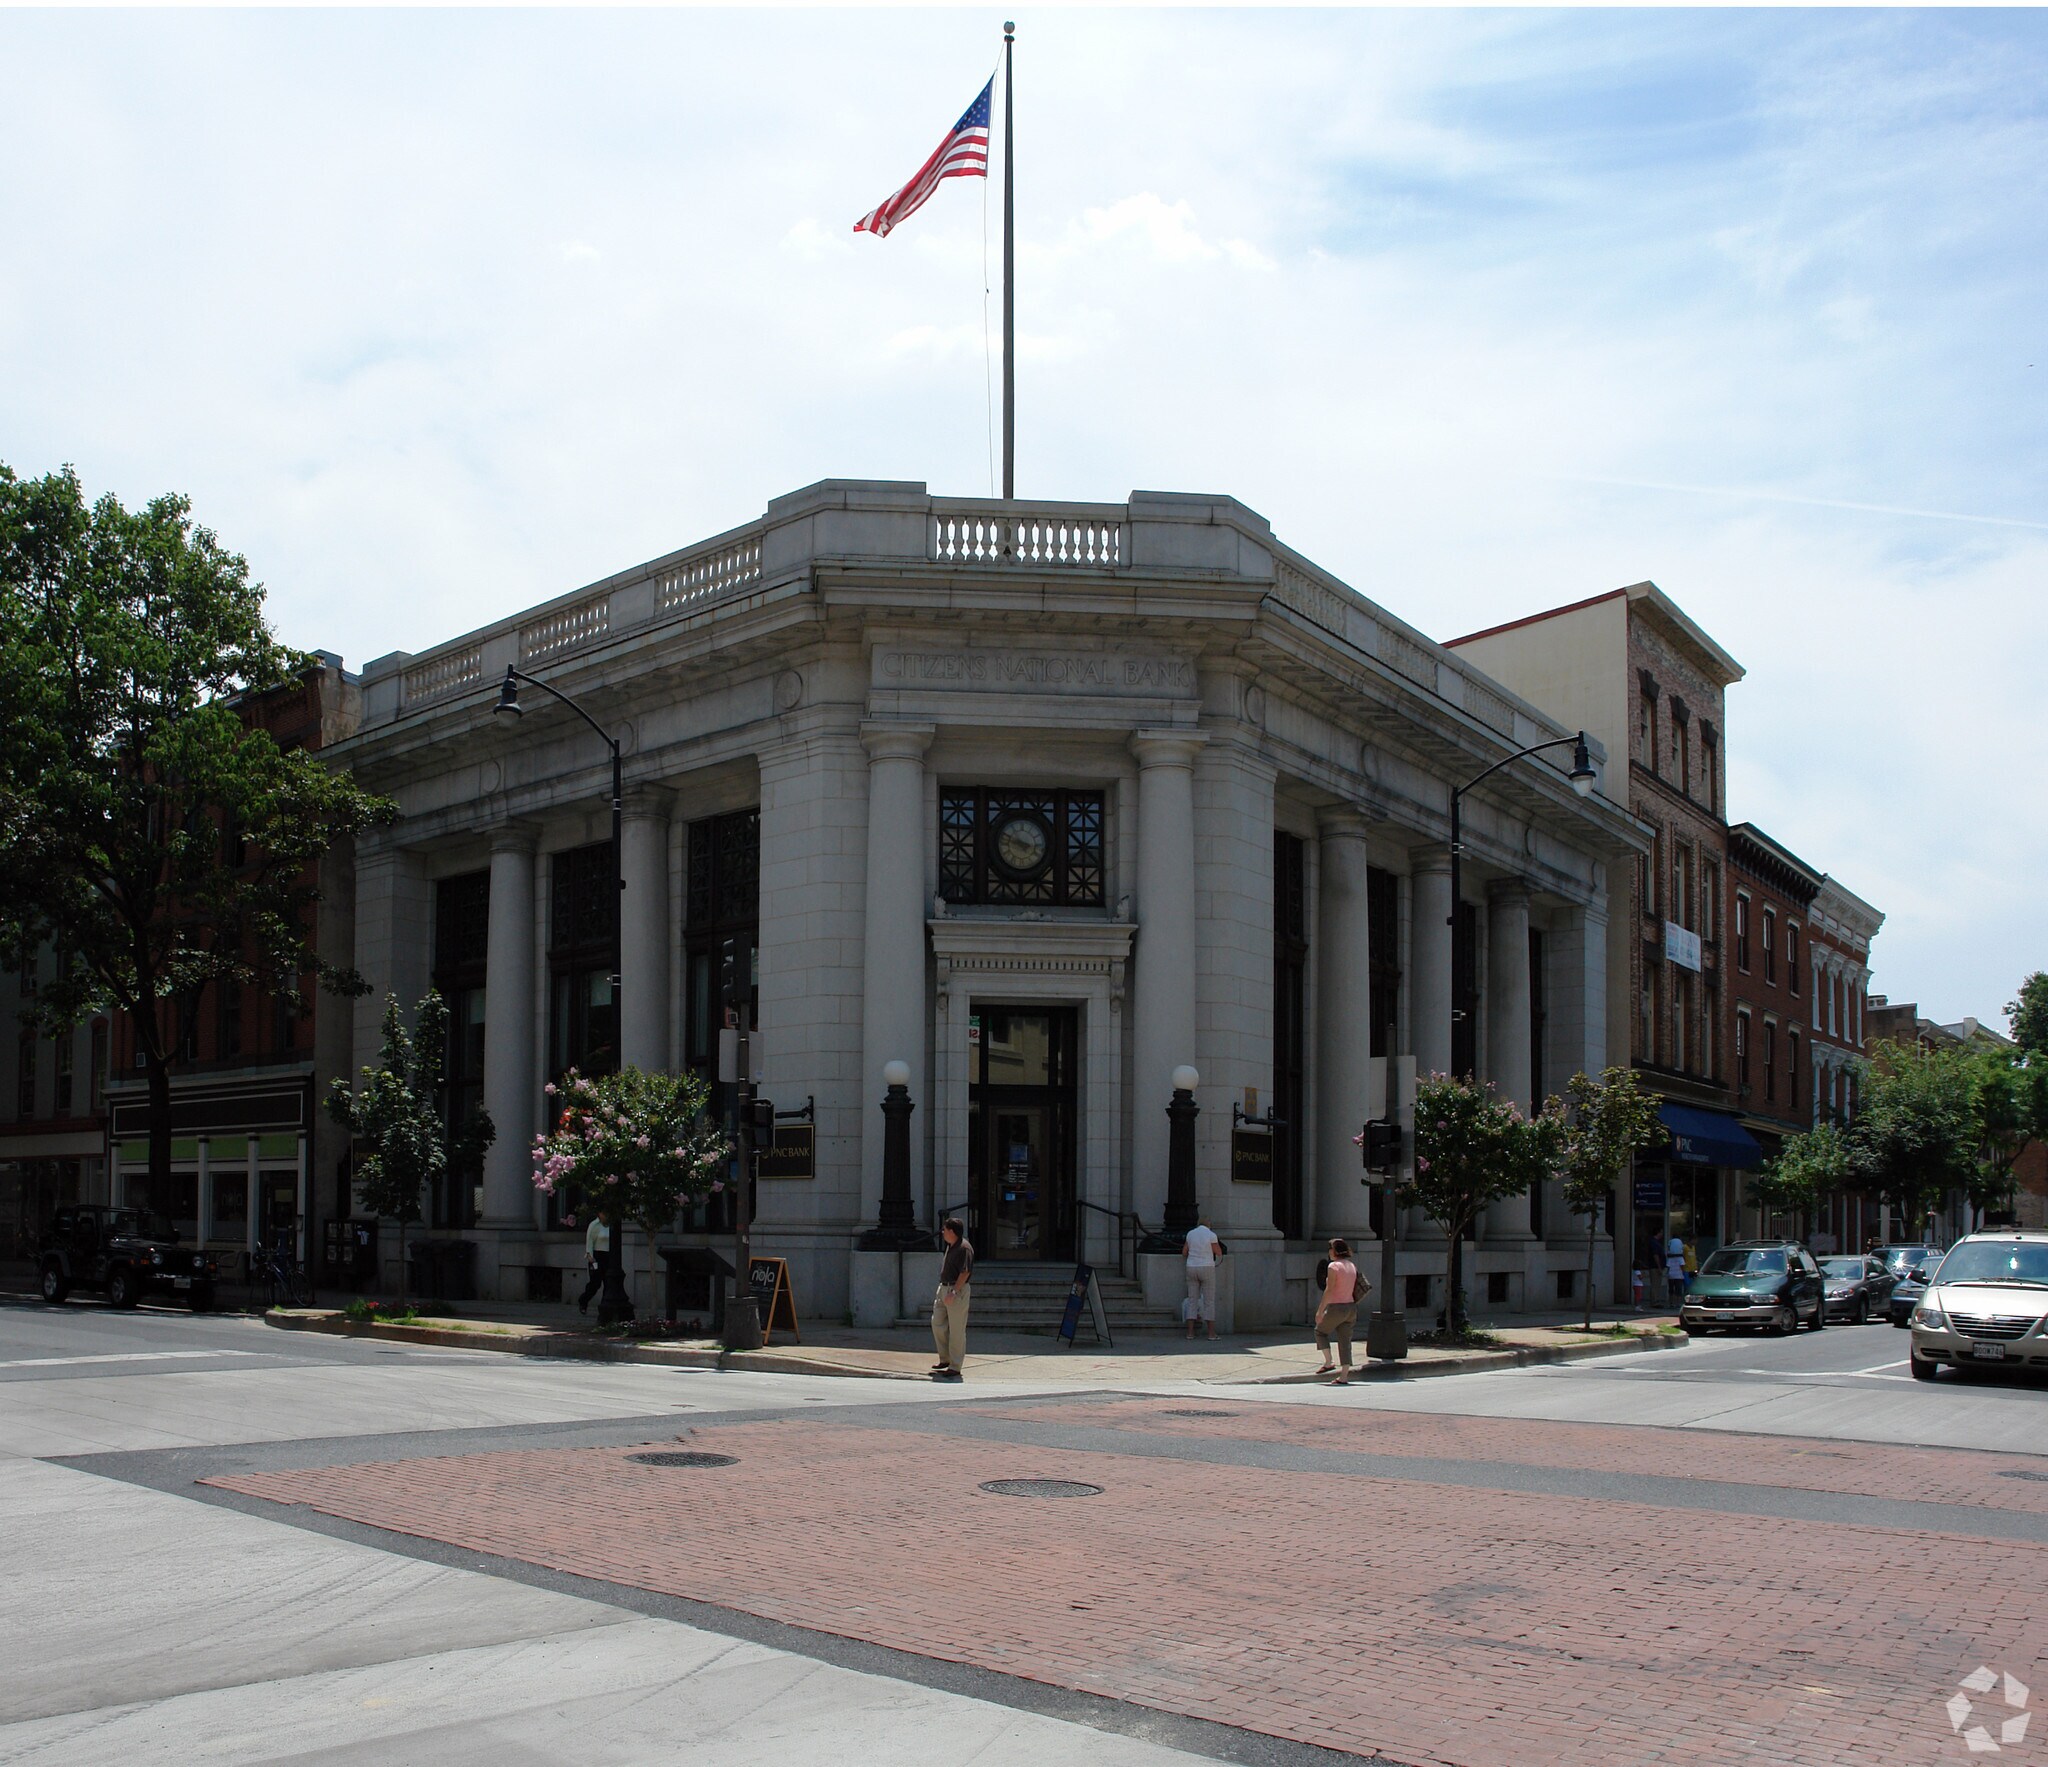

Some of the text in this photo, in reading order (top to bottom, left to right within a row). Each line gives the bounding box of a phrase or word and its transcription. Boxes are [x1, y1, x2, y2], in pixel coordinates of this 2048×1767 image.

[881, 652, 1190, 687] CITIZENS NATIONAL BANK
[751, 1266, 775, 1286] nola
